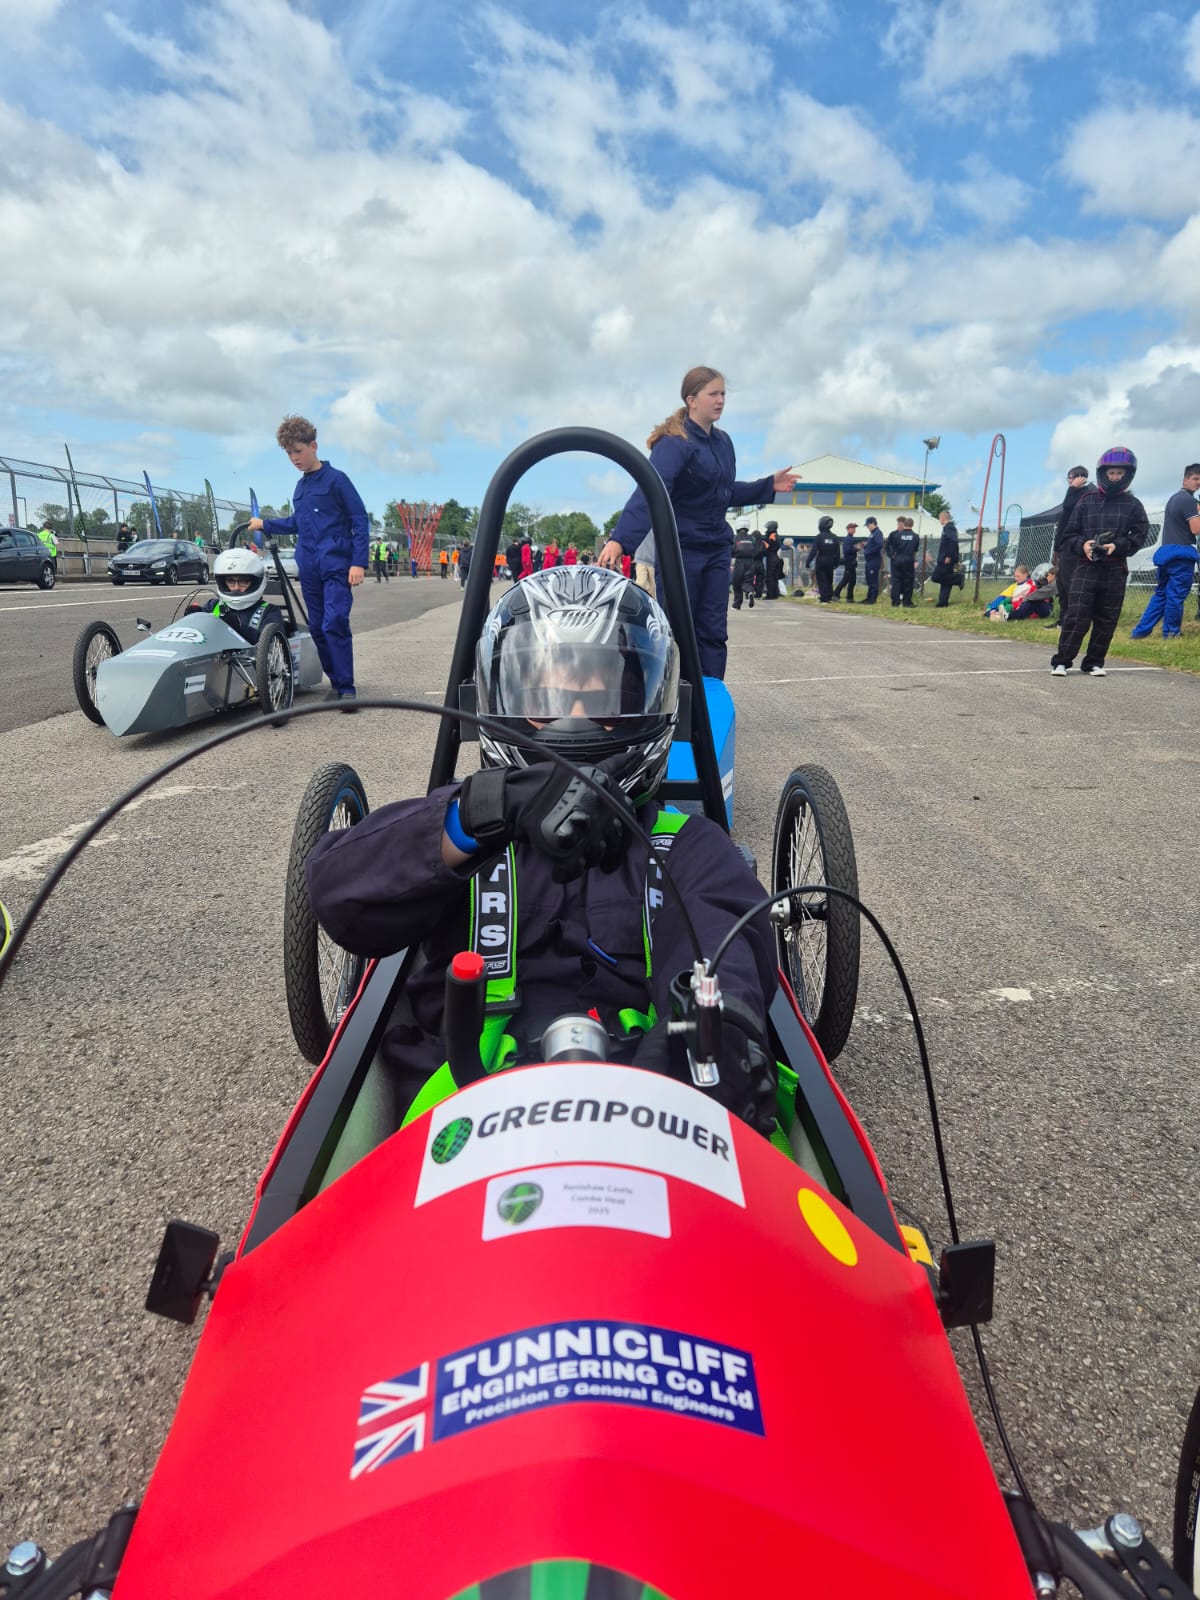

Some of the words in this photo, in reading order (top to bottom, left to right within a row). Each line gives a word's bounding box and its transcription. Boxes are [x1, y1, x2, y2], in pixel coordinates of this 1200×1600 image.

[477, 1099, 730, 1162] GREENPOWER
[444, 1326, 748, 1388] TUNNICLIFF
[441, 1359, 659, 1415] ENGINEERING
[665, 1369, 705, 1395] Co
[710, 1380, 755, 1411] Ltd
[465, 1389, 549, 1424] Precision
[574, 1382, 648, 1400] General
[651, 1389, 736, 1421] Engineers
